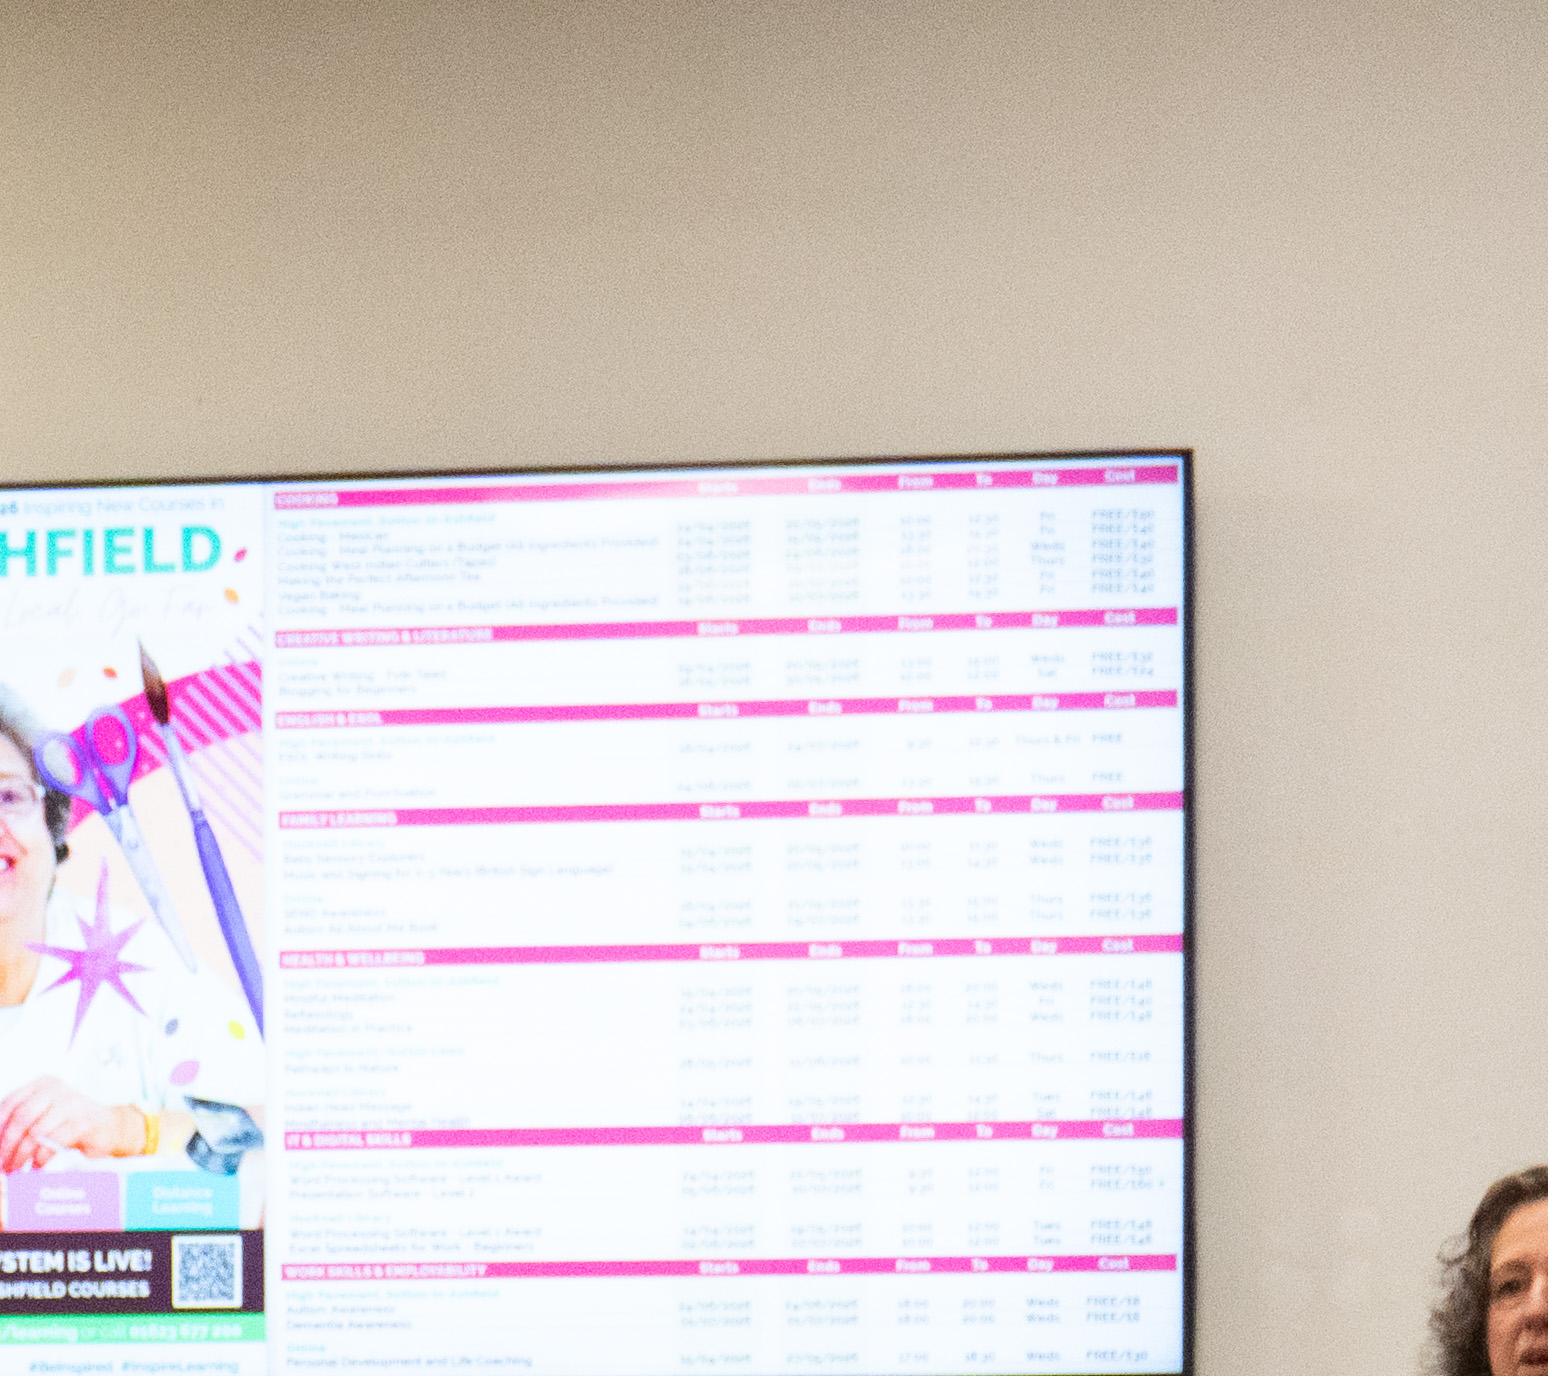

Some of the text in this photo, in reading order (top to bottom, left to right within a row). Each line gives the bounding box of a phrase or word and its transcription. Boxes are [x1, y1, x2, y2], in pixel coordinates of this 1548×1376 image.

[66, 1250, 91, 1272] IS
[93, 1249, 153, 1273] LIVE!
[67, 1280, 151, 1298] COURSES
